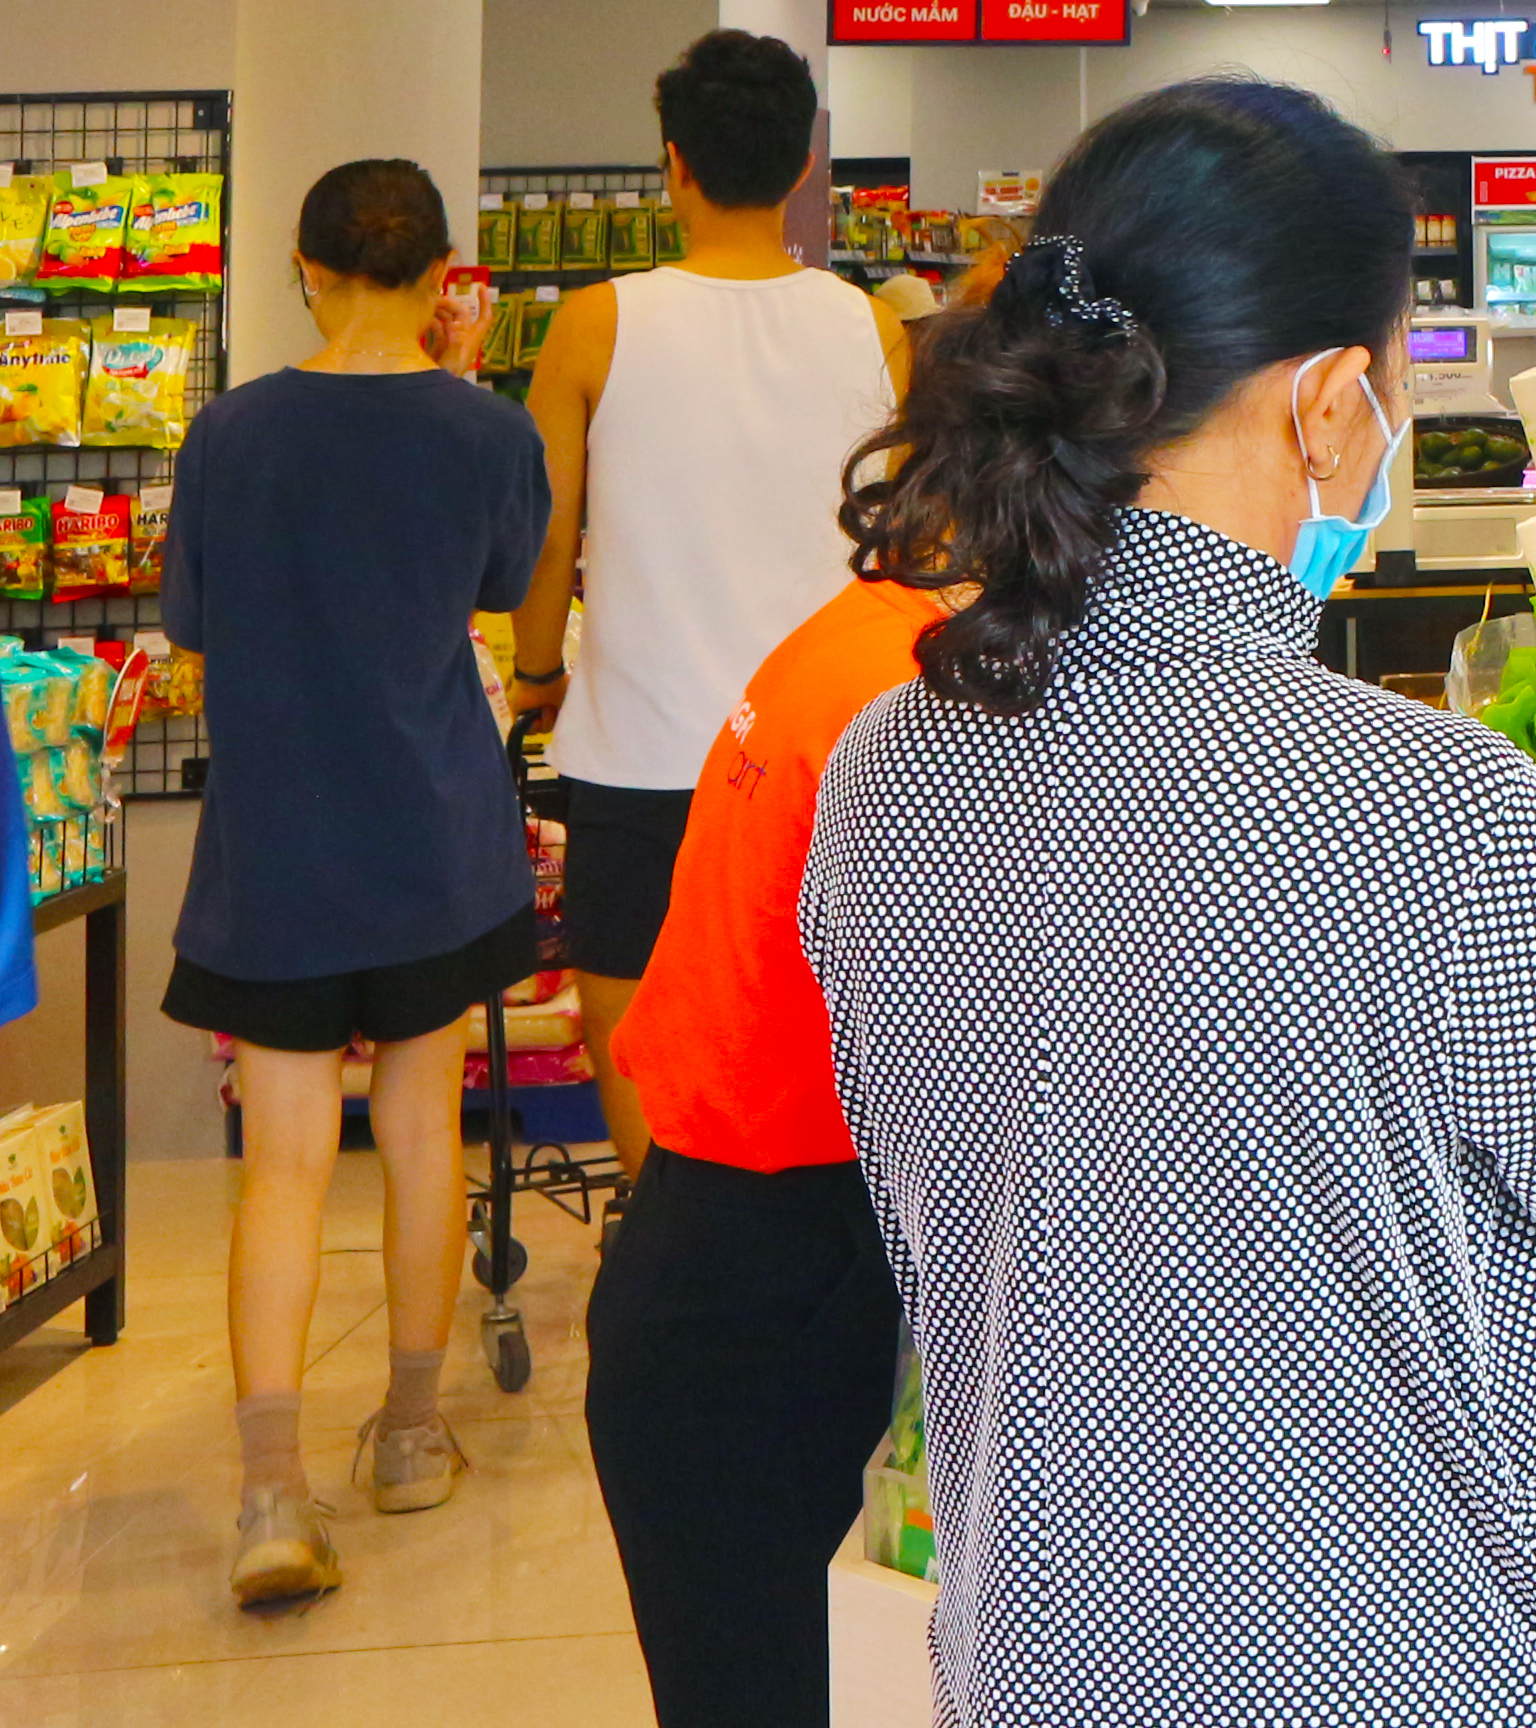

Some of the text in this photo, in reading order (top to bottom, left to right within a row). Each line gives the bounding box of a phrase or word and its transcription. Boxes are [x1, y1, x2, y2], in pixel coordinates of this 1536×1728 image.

[852, 1, 907, 23] NƯỚC
[1008, 0, 1100, 24] ĐẬU HẠT
[1420, 20, 1527, 73] THỊT
[1494, 167, 1536, 179] PIZZA
[56, 514, 120, 535] HARIBO
